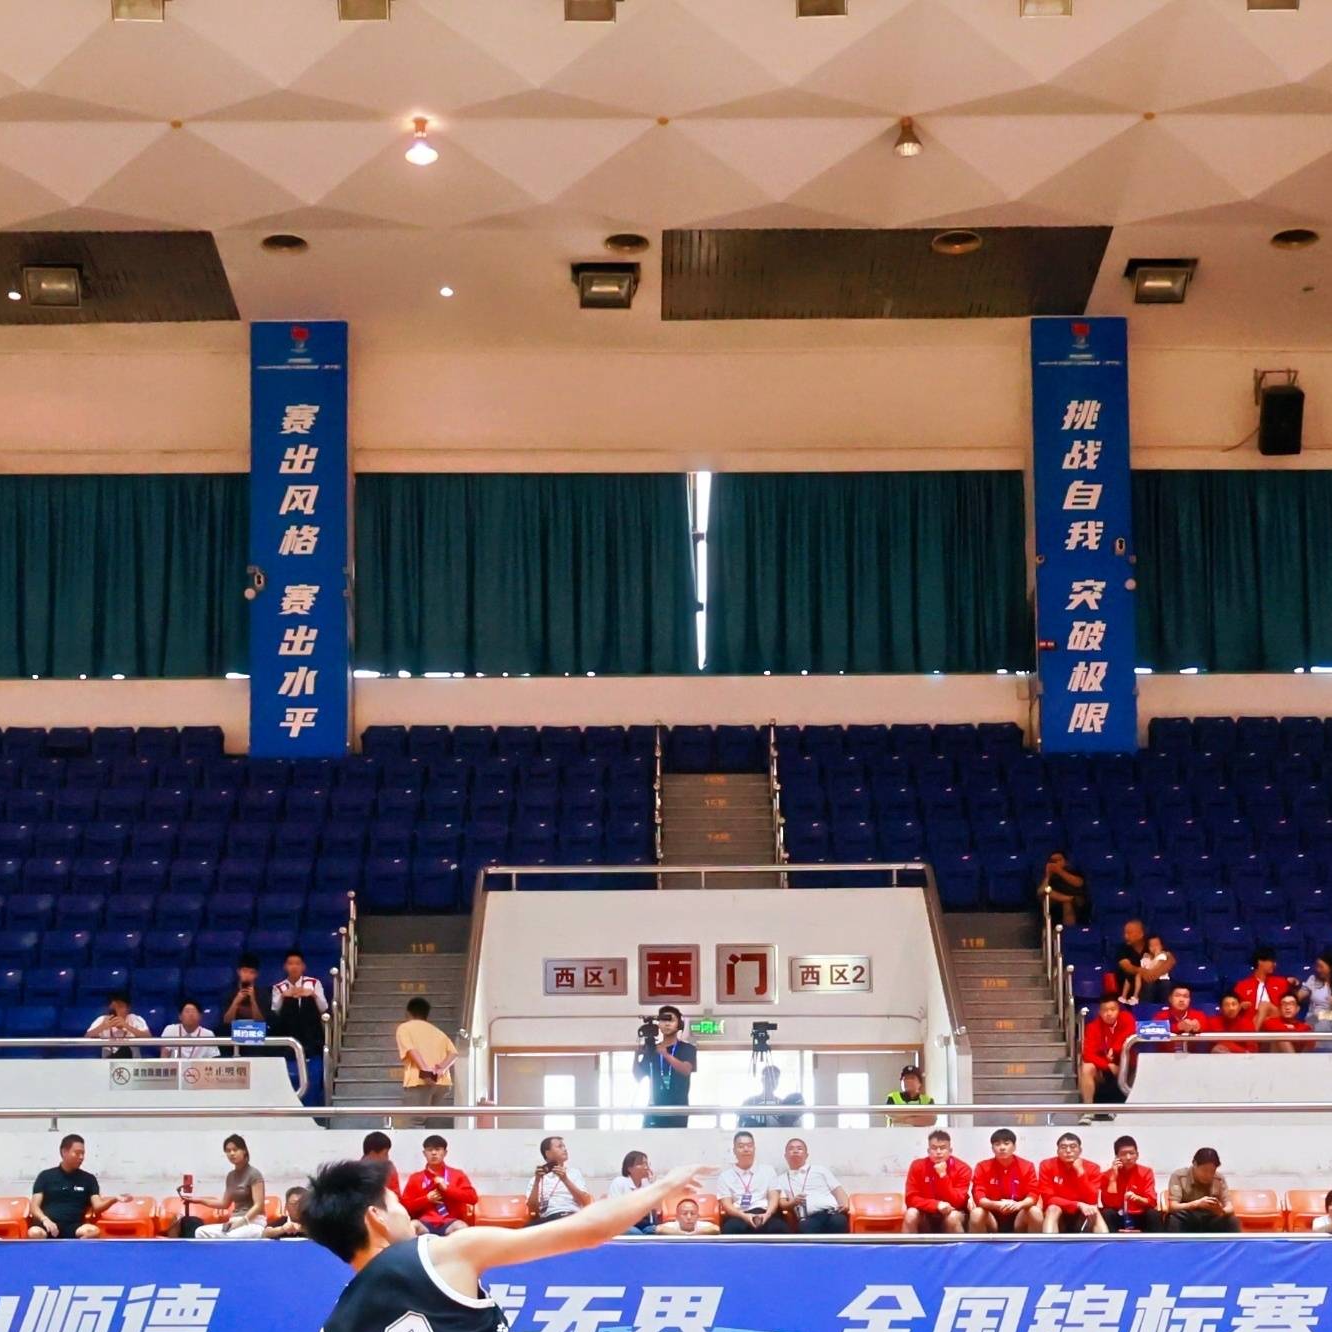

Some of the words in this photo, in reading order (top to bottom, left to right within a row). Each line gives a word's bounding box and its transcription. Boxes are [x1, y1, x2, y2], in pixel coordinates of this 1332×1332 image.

[278, 404, 320, 556] 赛出风格
[1061, 399, 1104, 551] 挑战自我
[278, 584, 320, 738] 赛出水平
[1065, 578, 1109, 734] 突破极限
[553, 966, 618, 989] 西区1
[647, 952, 768, 997] 西门
[799, 964, 866, 987] 西区2
